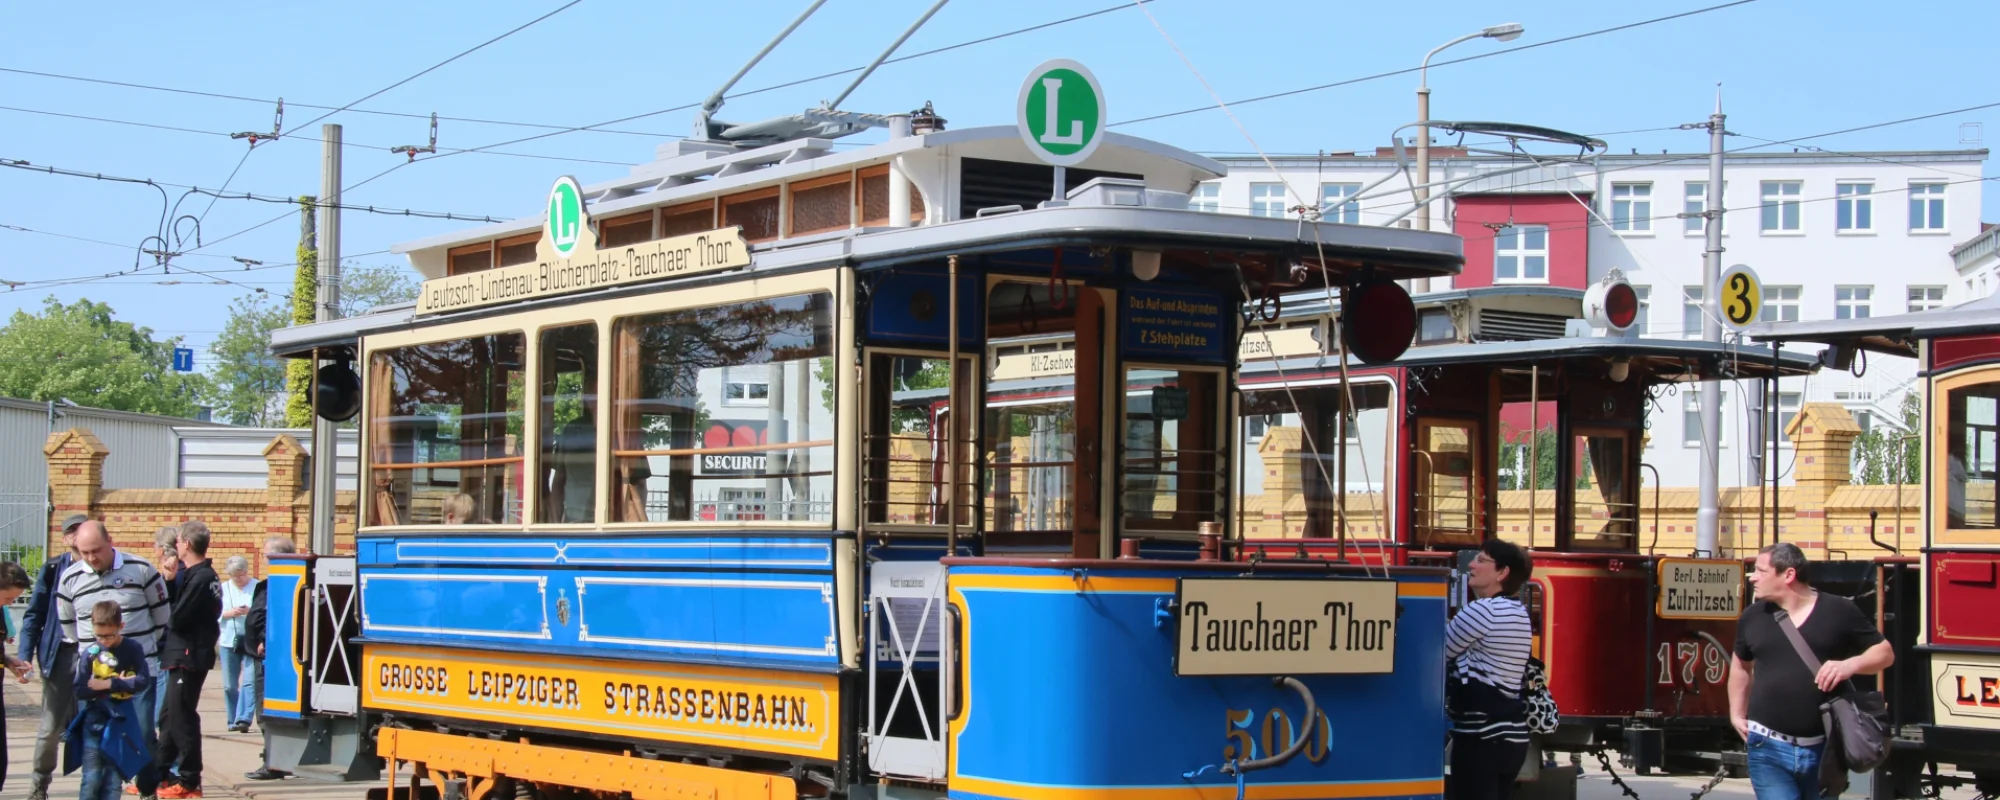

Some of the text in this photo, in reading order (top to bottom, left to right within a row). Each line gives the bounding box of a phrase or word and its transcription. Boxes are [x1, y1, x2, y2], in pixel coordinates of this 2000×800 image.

[1040, 77, 1083, 145] L
[554, 191, 575, 246] L
[696, 235, 733, 268] Thor
[1129, 295, 1144, 309] Das
[1728, 272, 1752, 325] 3
[178, 351, 189, 369] T
[1031, 354, 1075, 372] Kl-Zschoc
[704, 455, 767, 470] SECURIT
[1674, 567, 1730, 584] Berl. Bahnhof
[1667, 588, 1734, 611] Eutritzsch
[1184, 601, 1392, 652] Tauchaer Thor
[1657, 642, 1727, 686] 179
[380, 663, 815, 732] GROSSE LEIPZIGER STRASSENBAHN.
[1224, 708, 1333, 764] 500
